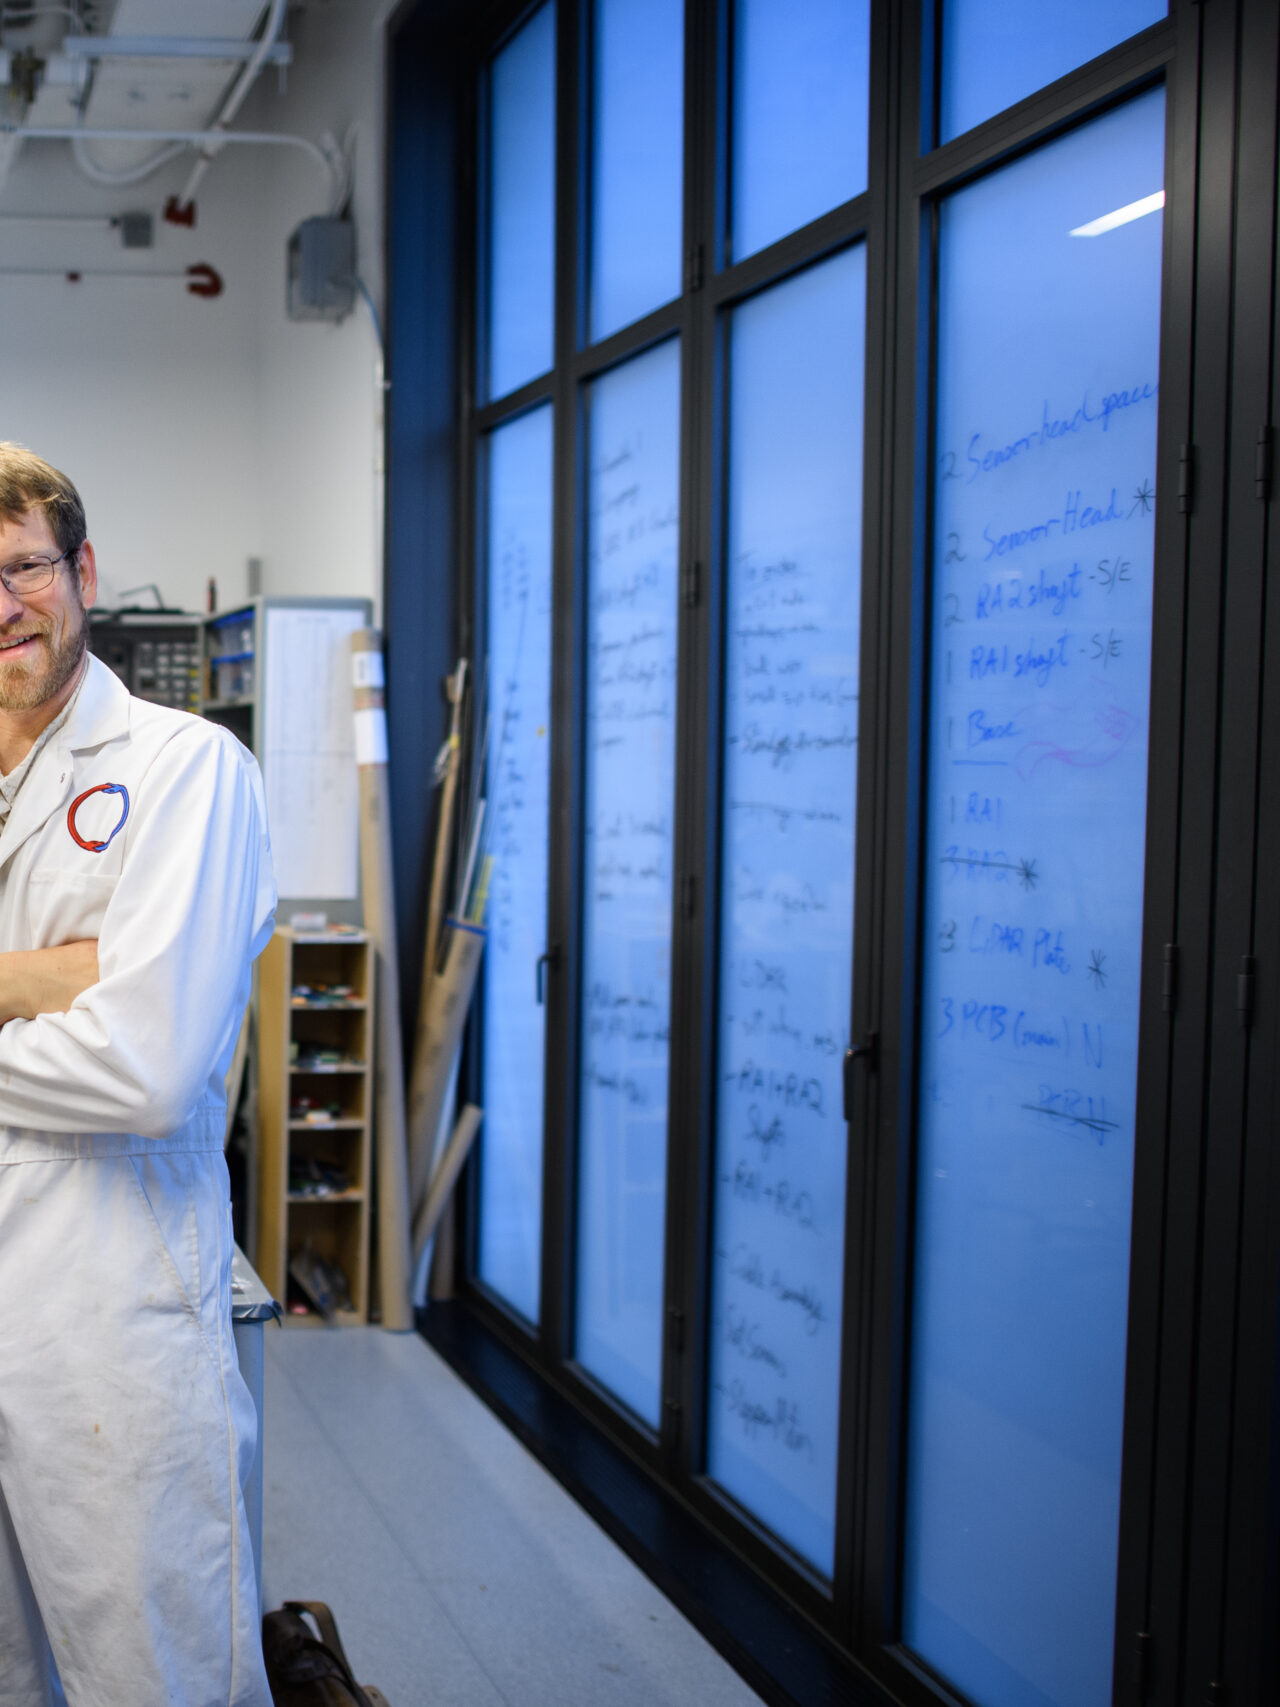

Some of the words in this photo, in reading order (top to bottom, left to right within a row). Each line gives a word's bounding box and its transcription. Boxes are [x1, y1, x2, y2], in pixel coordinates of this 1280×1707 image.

[945, 532, 966, 564] 2
[944, 593, 964, 628] 2
[937, 998, 953, 1039] 3
[960, 1001, 1009, 1044] PCB
